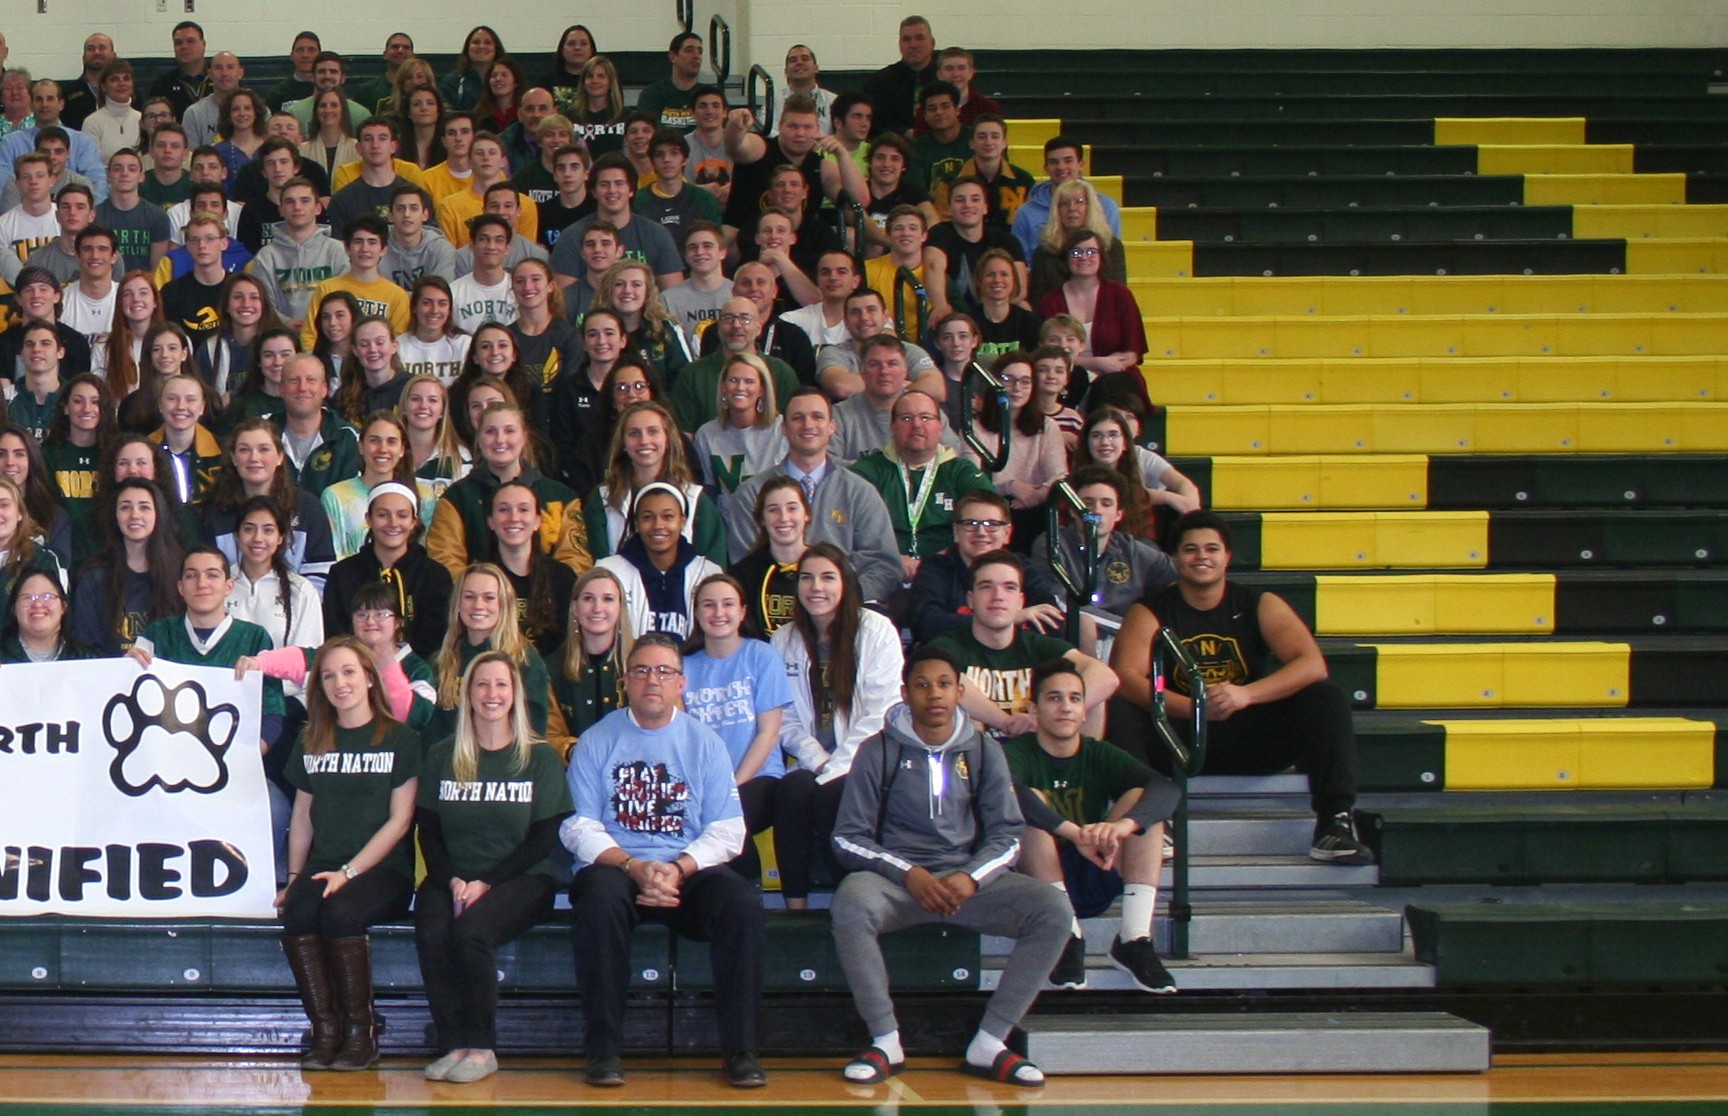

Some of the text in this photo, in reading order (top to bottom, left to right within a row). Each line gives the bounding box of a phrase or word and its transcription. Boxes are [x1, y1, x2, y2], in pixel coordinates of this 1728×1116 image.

[460, 300, 516, 320] NORTH
[1200, 640, 1217, 656] N
[341, 751, 395, 775] NATION
[618, 766, 661, 785] PLAY
[618, 799, 657, 816] LIVE
